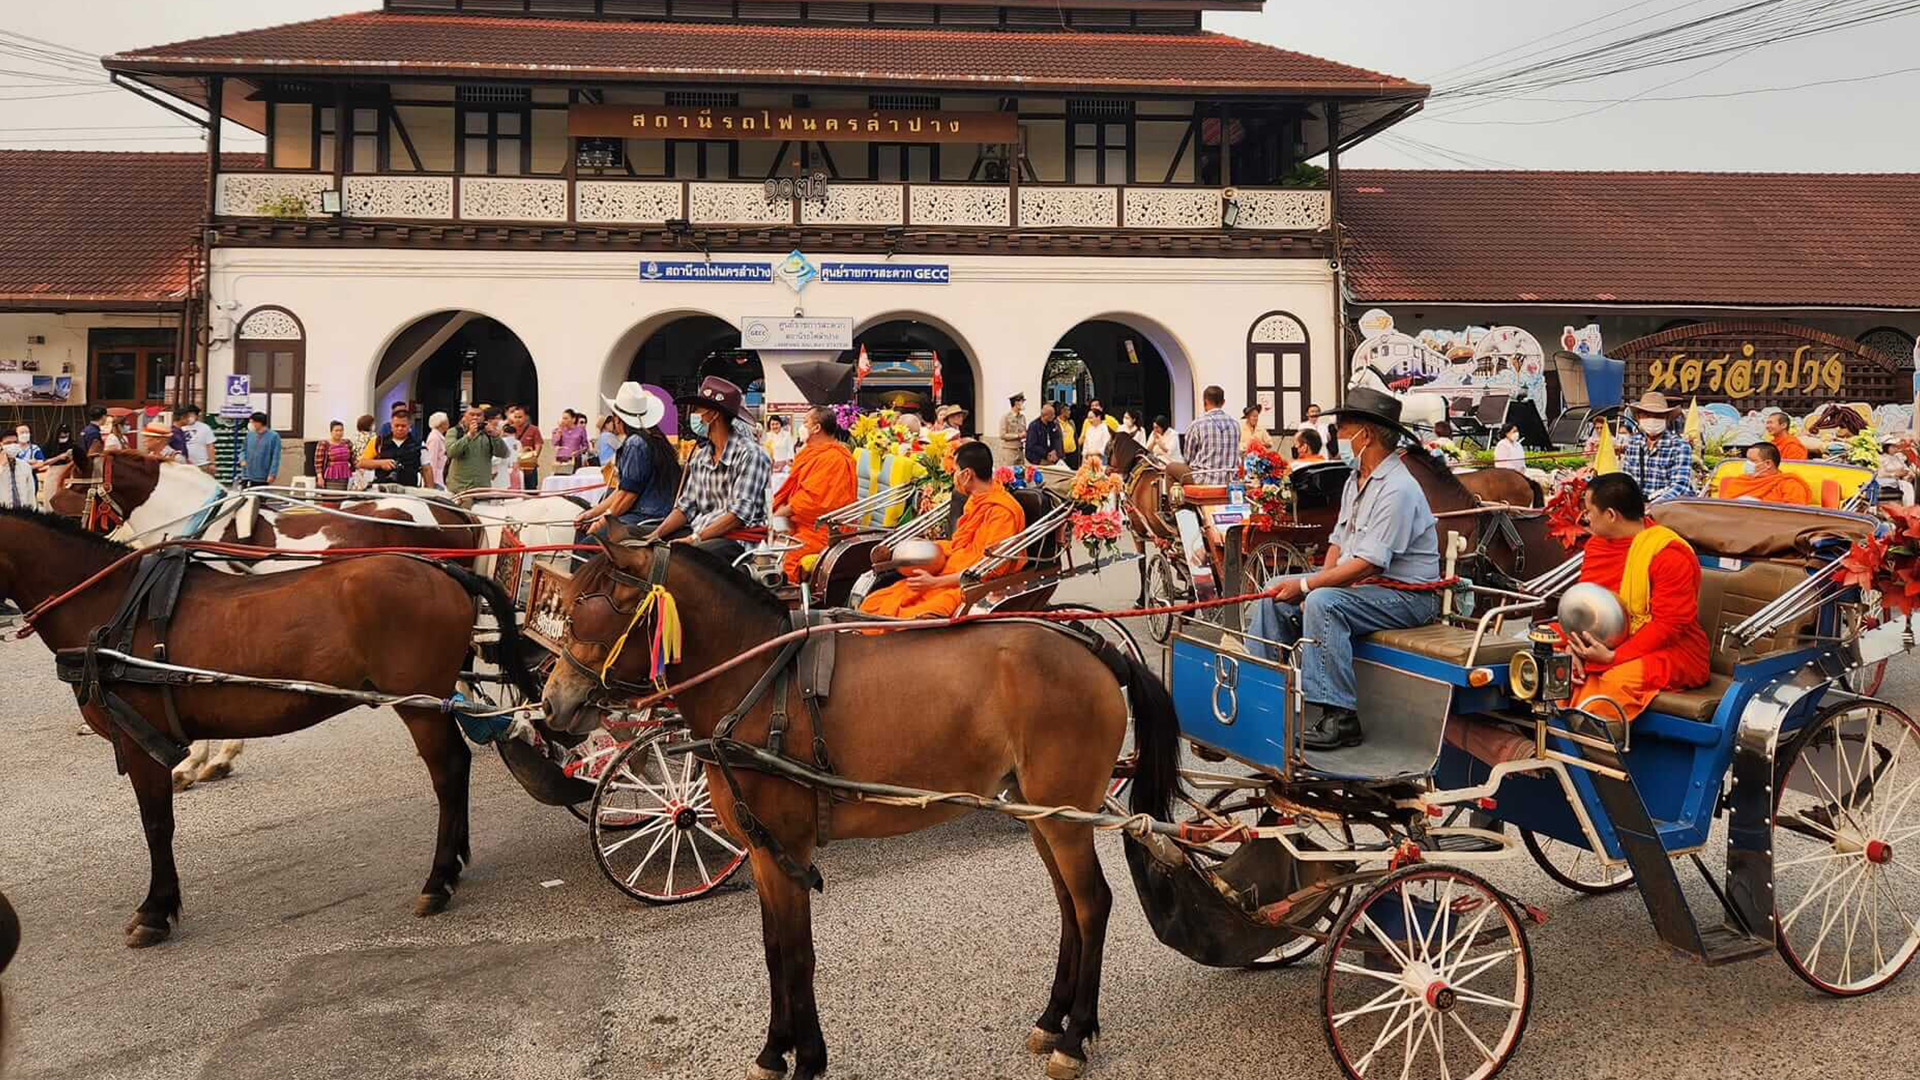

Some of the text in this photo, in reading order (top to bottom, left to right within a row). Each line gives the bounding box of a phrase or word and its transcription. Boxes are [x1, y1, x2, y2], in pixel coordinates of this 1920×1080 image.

[632, 108, 960, 133] สถานีรถไฟนครลำปาง
[665, 263, 771, 278] สถานีรถไฟนครลำปาง
[821, 264, 949, 282] ศูนย์ราชการสะดวก GECC
[1647, 344, 1843, 398] นครลำปาง
